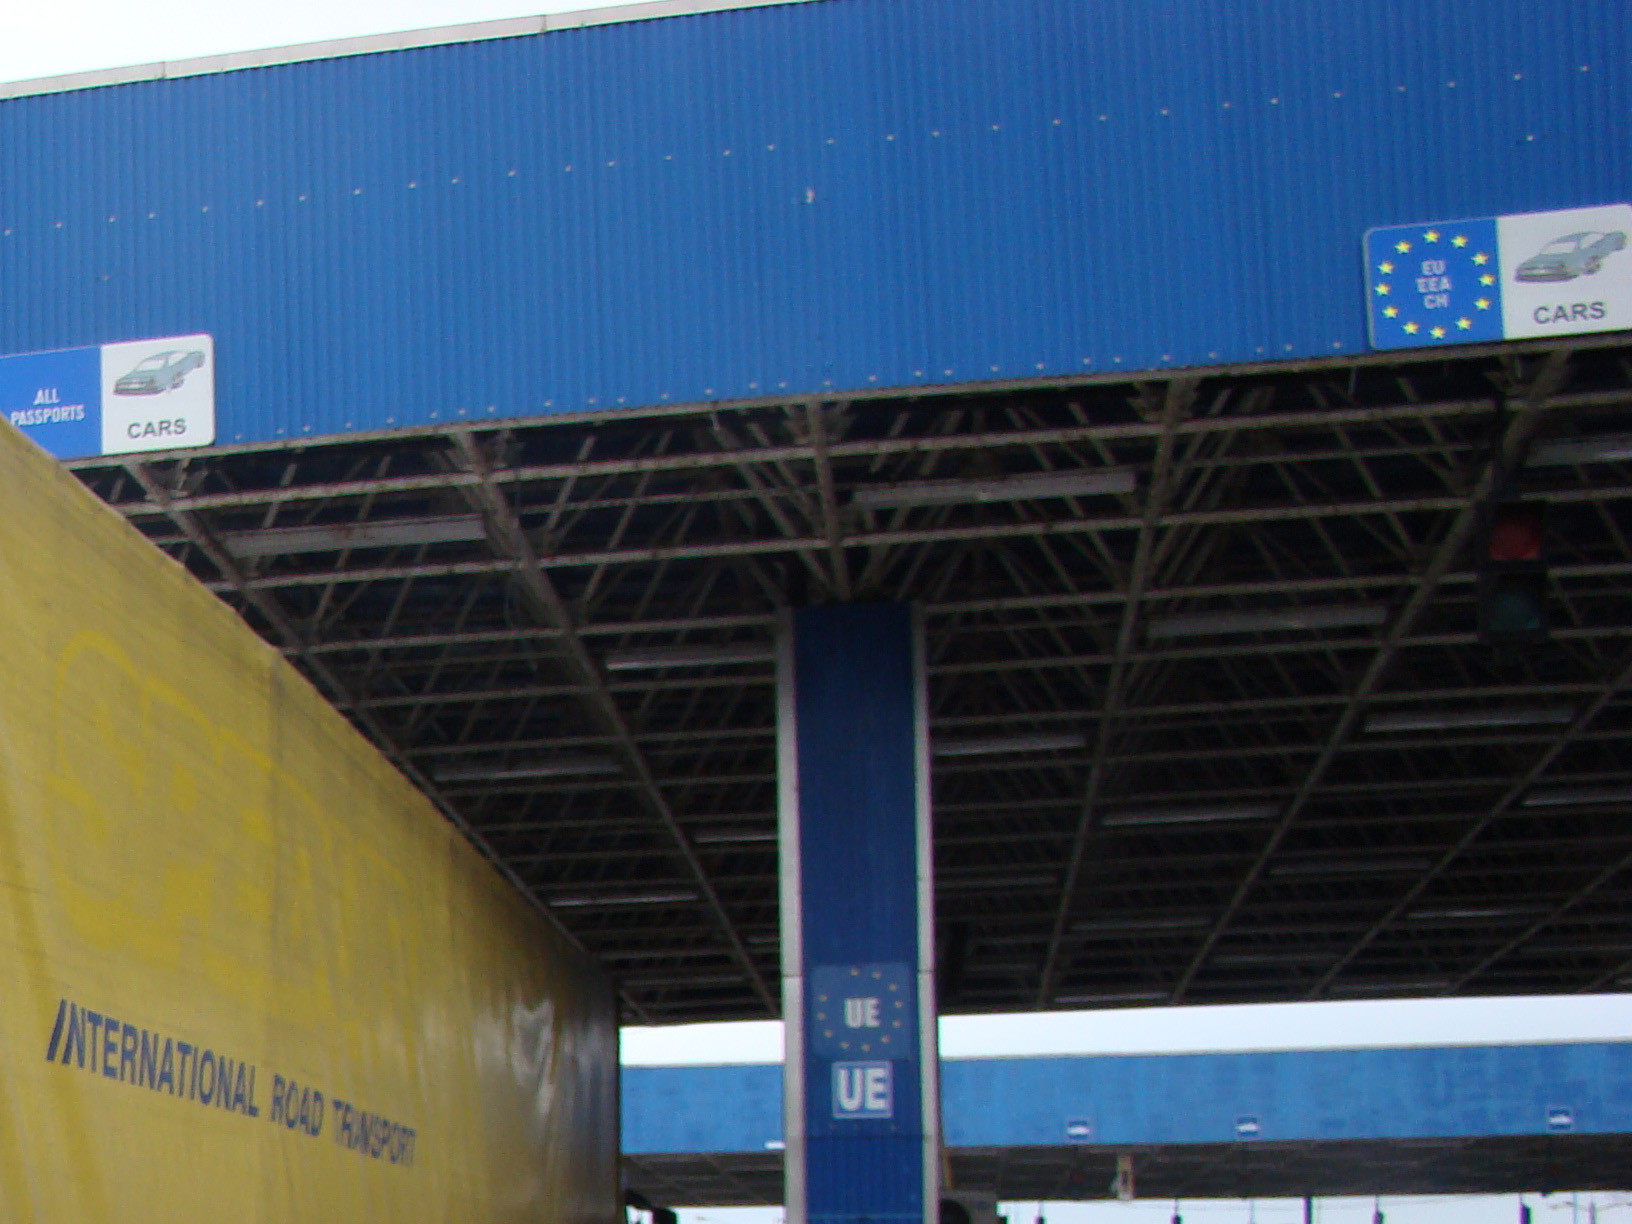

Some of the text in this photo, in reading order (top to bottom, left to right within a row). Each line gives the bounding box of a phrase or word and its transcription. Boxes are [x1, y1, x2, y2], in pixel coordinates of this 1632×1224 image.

[1422, 260, 1445, 275] EU
[1533, 301, 1607, 325] CARS
[34, 388, 60, 404] ALL
[10, 403, 85, 426] PASSPORTS
[127, 417, 187, 440] CARS
[845, 998, 880, 1027] UE
[46, 998, 417, 1168] INTERNATIONAL ROAD TRANSPORT
[837, 1068, 887, 1111] UE
